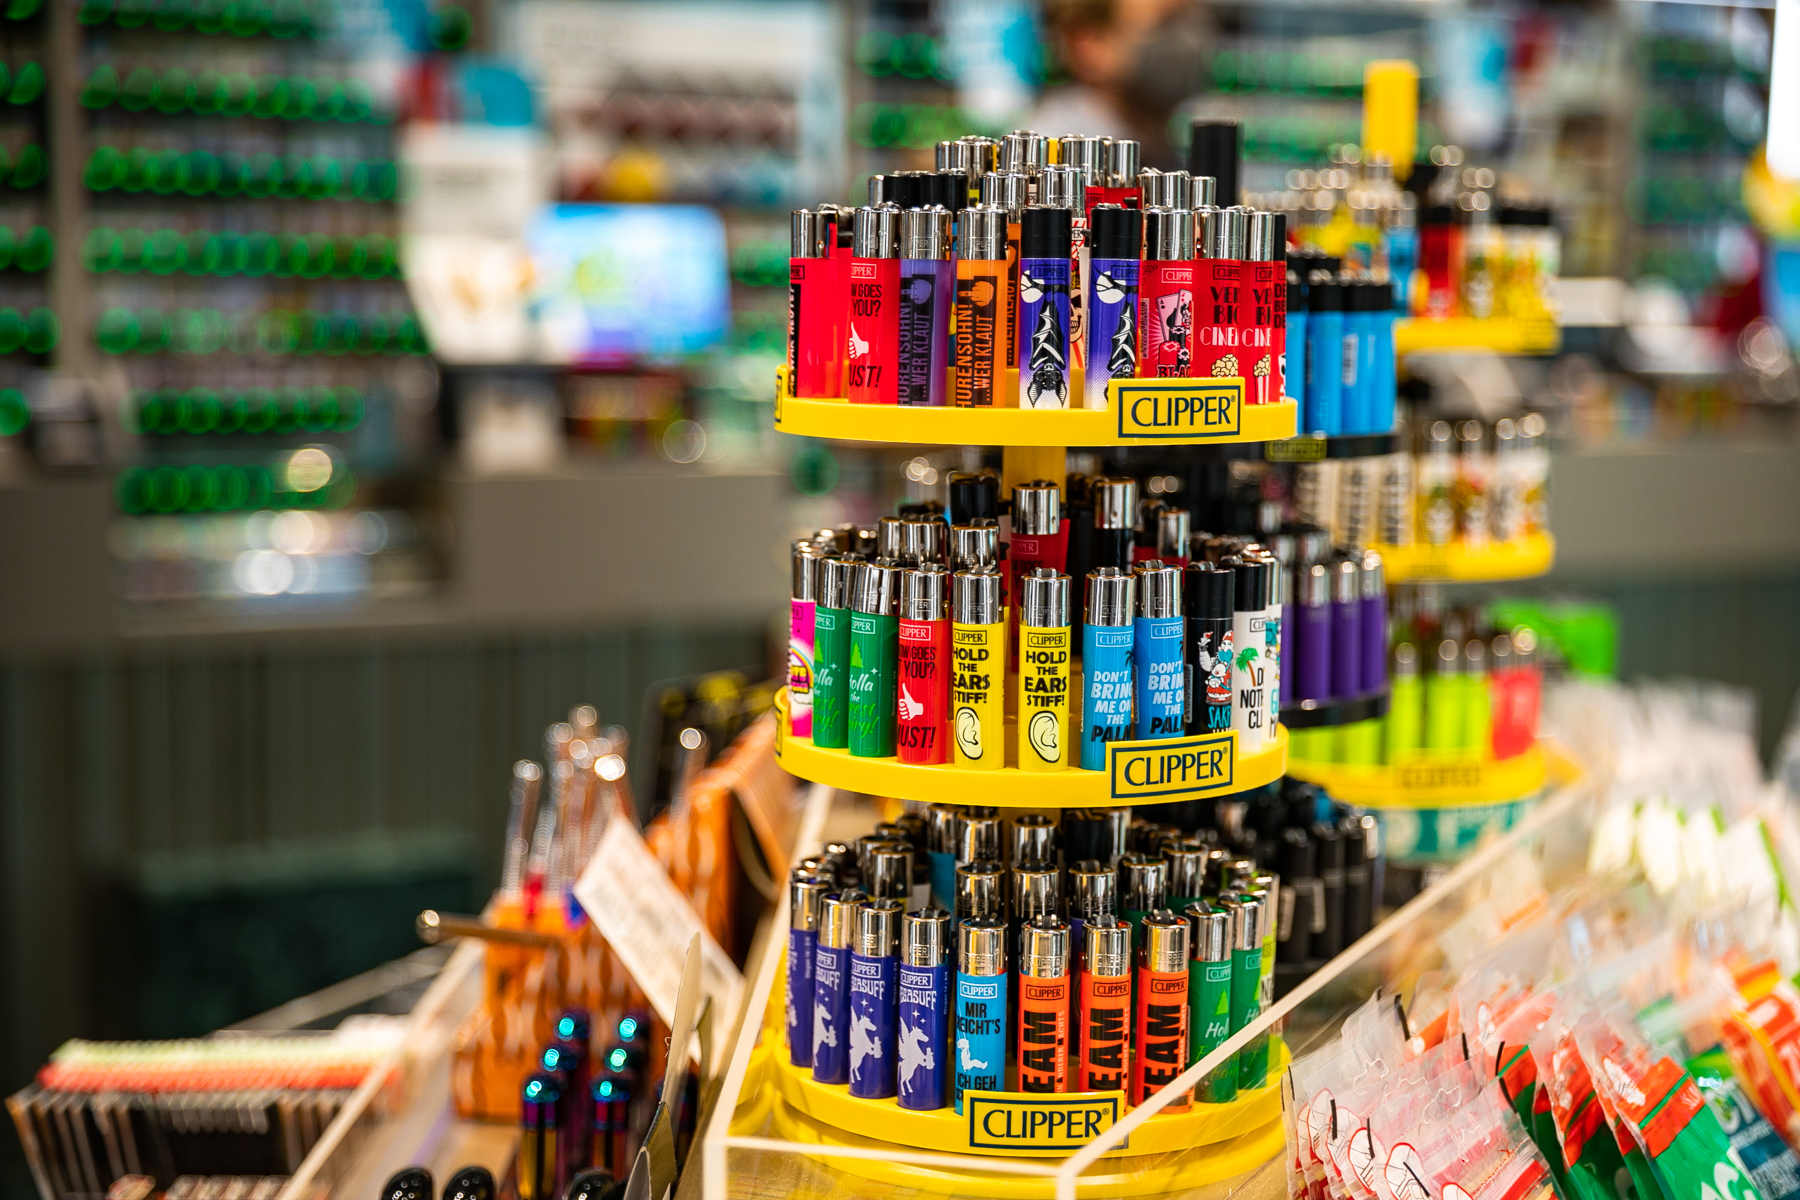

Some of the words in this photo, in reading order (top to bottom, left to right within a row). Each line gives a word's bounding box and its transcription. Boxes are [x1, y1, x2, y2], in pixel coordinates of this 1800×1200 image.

[1033, 268, 1064, 278] CLIPPER
[858, 284, 882, 298] GOES
[852, 299, 882, 317] YOU?
[913, 312, 931, 354] KLAUT
[975, 315, 993, 359] KLAUT
[956, 303, 973, 408] HURENSOHN!
[954, 631, 983, 643] CLIPPER
[1030, 635, 1064, 646] CLIPPER
[1099, 634, 1131, 645] CLIPPER
[911, 646, 936, 661] GOES
[953, 647, 990, 662] HOLD
[1025, 650, 1067, 664] HOLD
[904, 661, 935, 679] YOU?
[958, 662, 978, 673] THE
[1036, 666, 1058, 676] THE
[1149, 660, 1183, 674] DON'T
[1093, 670, 1129, 683] DON'T
[1024, 676, 1067, 694] EARS
[1026, 694, 1065, 708] STIFF!
[1152, 691, 1174, 705] ME
[1094, 700, 1117, 714] ME
[1164, 703, 1182, 716] THE
[1106, 714, 1125, 725] THE
[901, 974, 929, 986] CLIPPER
[1154, 980, 1185, 992] CLIPPER
[961, 985, 995, 996] CLIPPER
[1028, 987, 1062, 998] CLIPPER
[1096, 984, 1128, 995] CLIPPER
[965, 1001, 987, 1018] MIR
[1057, 1010, 1066, 1046] MACHTS
[1056, 1046, 1065, 1083] ANDERER
[957, 1071, 972, 1089] ICH
[975, 1074, 997, 1090] GEH
